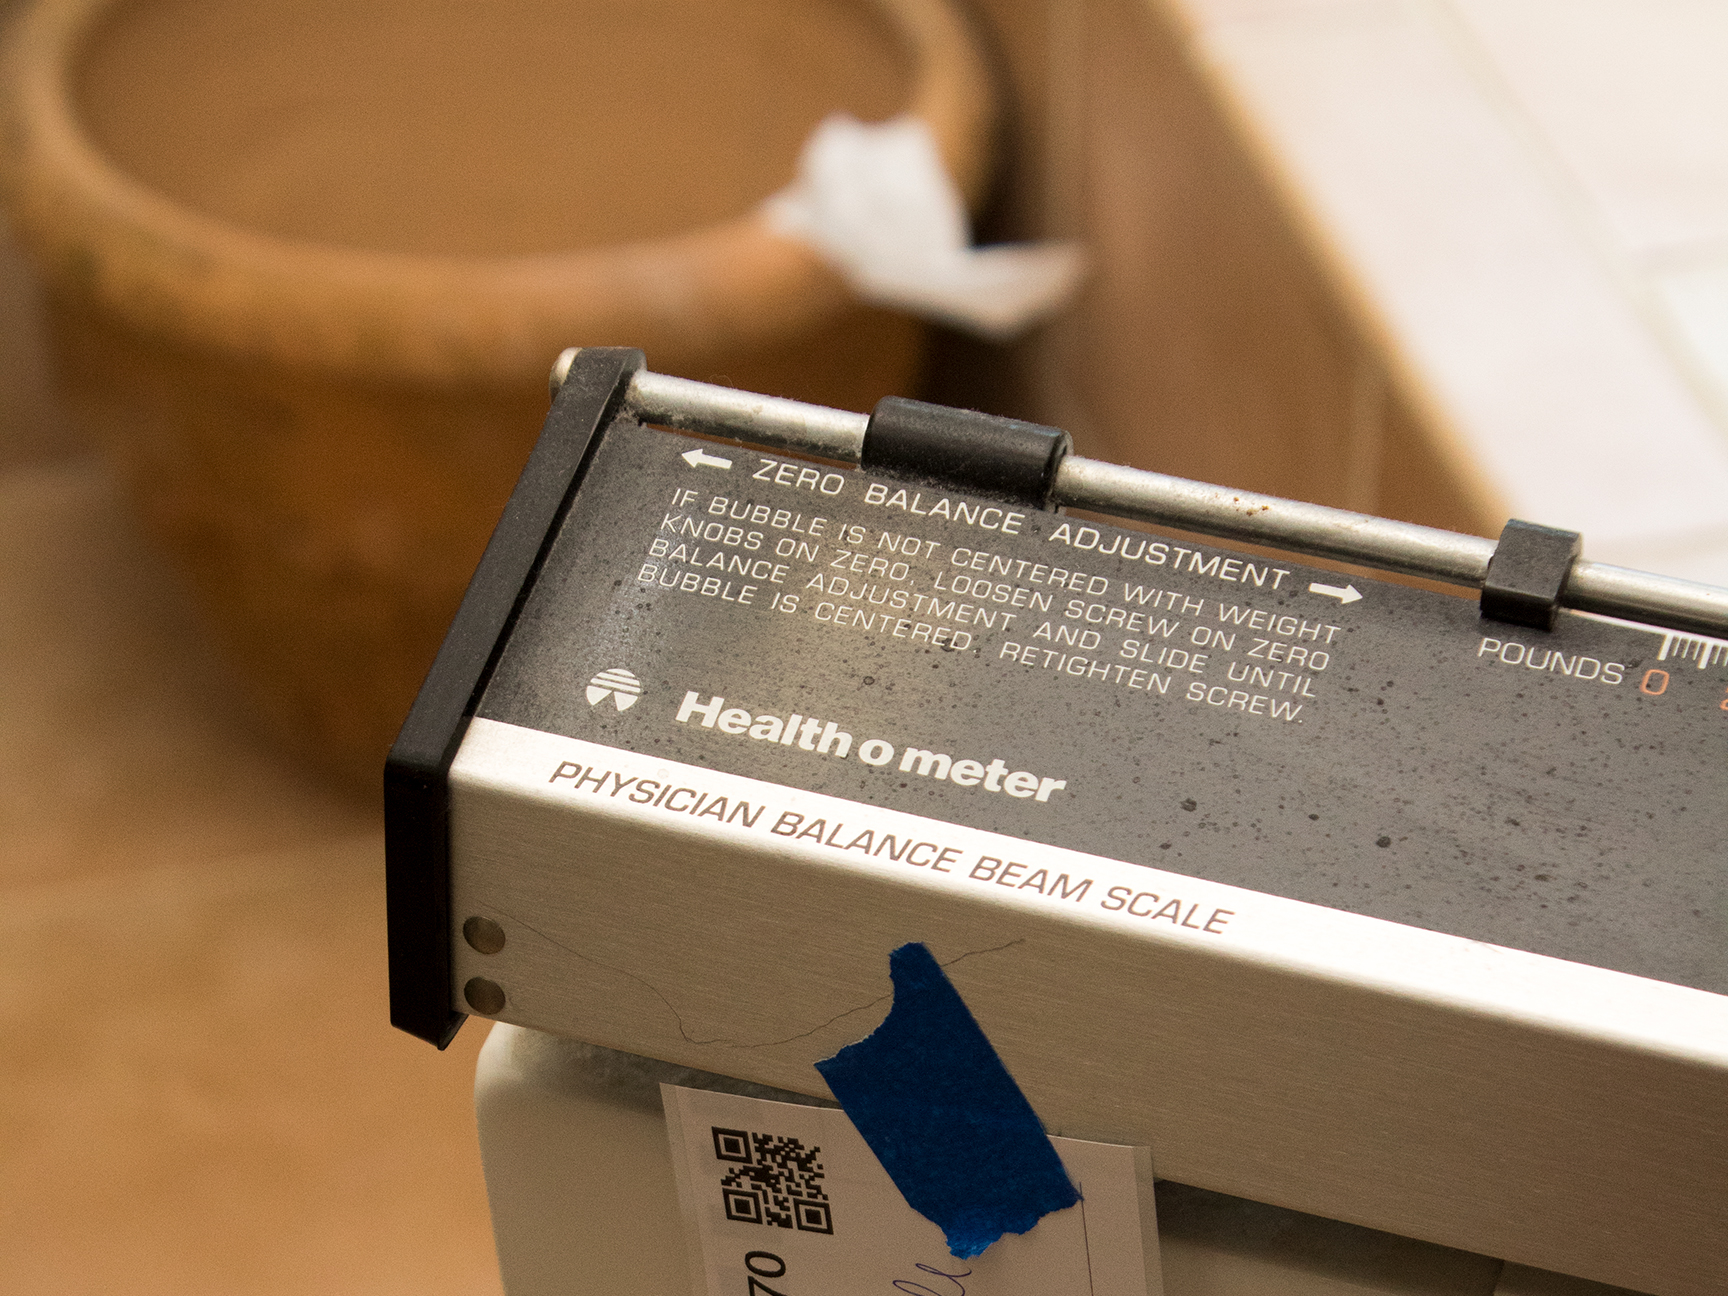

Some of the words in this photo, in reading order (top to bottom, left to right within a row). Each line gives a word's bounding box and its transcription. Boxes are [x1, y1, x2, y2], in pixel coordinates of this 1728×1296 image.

[660, 513, 764, 551] KNOBS
[775, 538, 820, 563] ON
[830, 549, 916, 586] ZERO,
[933, 572, 1054, 612] LOOSEN
[1064, 600, 1180, 639] SCREW
[1190, 626, 1236, 652] ON
[1246, 638, 1331, 671] ZERO
[671, 488, 699, 508] IF
[708, 496, 828, 537] BUBBLE
[838, 523, 867, 545] IS
[877, 531, 941, 560] NOT
[951, 547, 1109, 596] CENTERED
[1124, 582, 1205, 616] WITH
[1218, 603, 1342, 645] WEIGHT
[752, 458, 846, 496] ZERO
[864, 483, 1026, 535] BALANCE
[1048, 523, 1291, 592] ADJUSTMENT
[637, 563, 758, 605] BUBBLE
[771, 592, 801, 614] IS
[814, 602, 979, 654] CENTERED.
[1000, 642, 1172, 694] RETIGHTEN
[1186, 682, 1304, 723] SCREW.
[649, 538, 790, 584] BALANCE
[806, 573, 1017, 632] ADJUSTMENT
[1033, 621, 1102, 651] AND
[1120, 639, 1209, 674] SLIDE
[1226, 661, 1317, 698] UNTIL
[1477, 637, 1626, 685] POUNDS
[1640, 669, 1671, 696] 0
[548, 760, 766, 831] PHYSICIAN
[769, 810, 964, 874] BALANCE
[968, 855, 1093, 903] BEAM
[1100, 885, 1236, 935] SCALE
